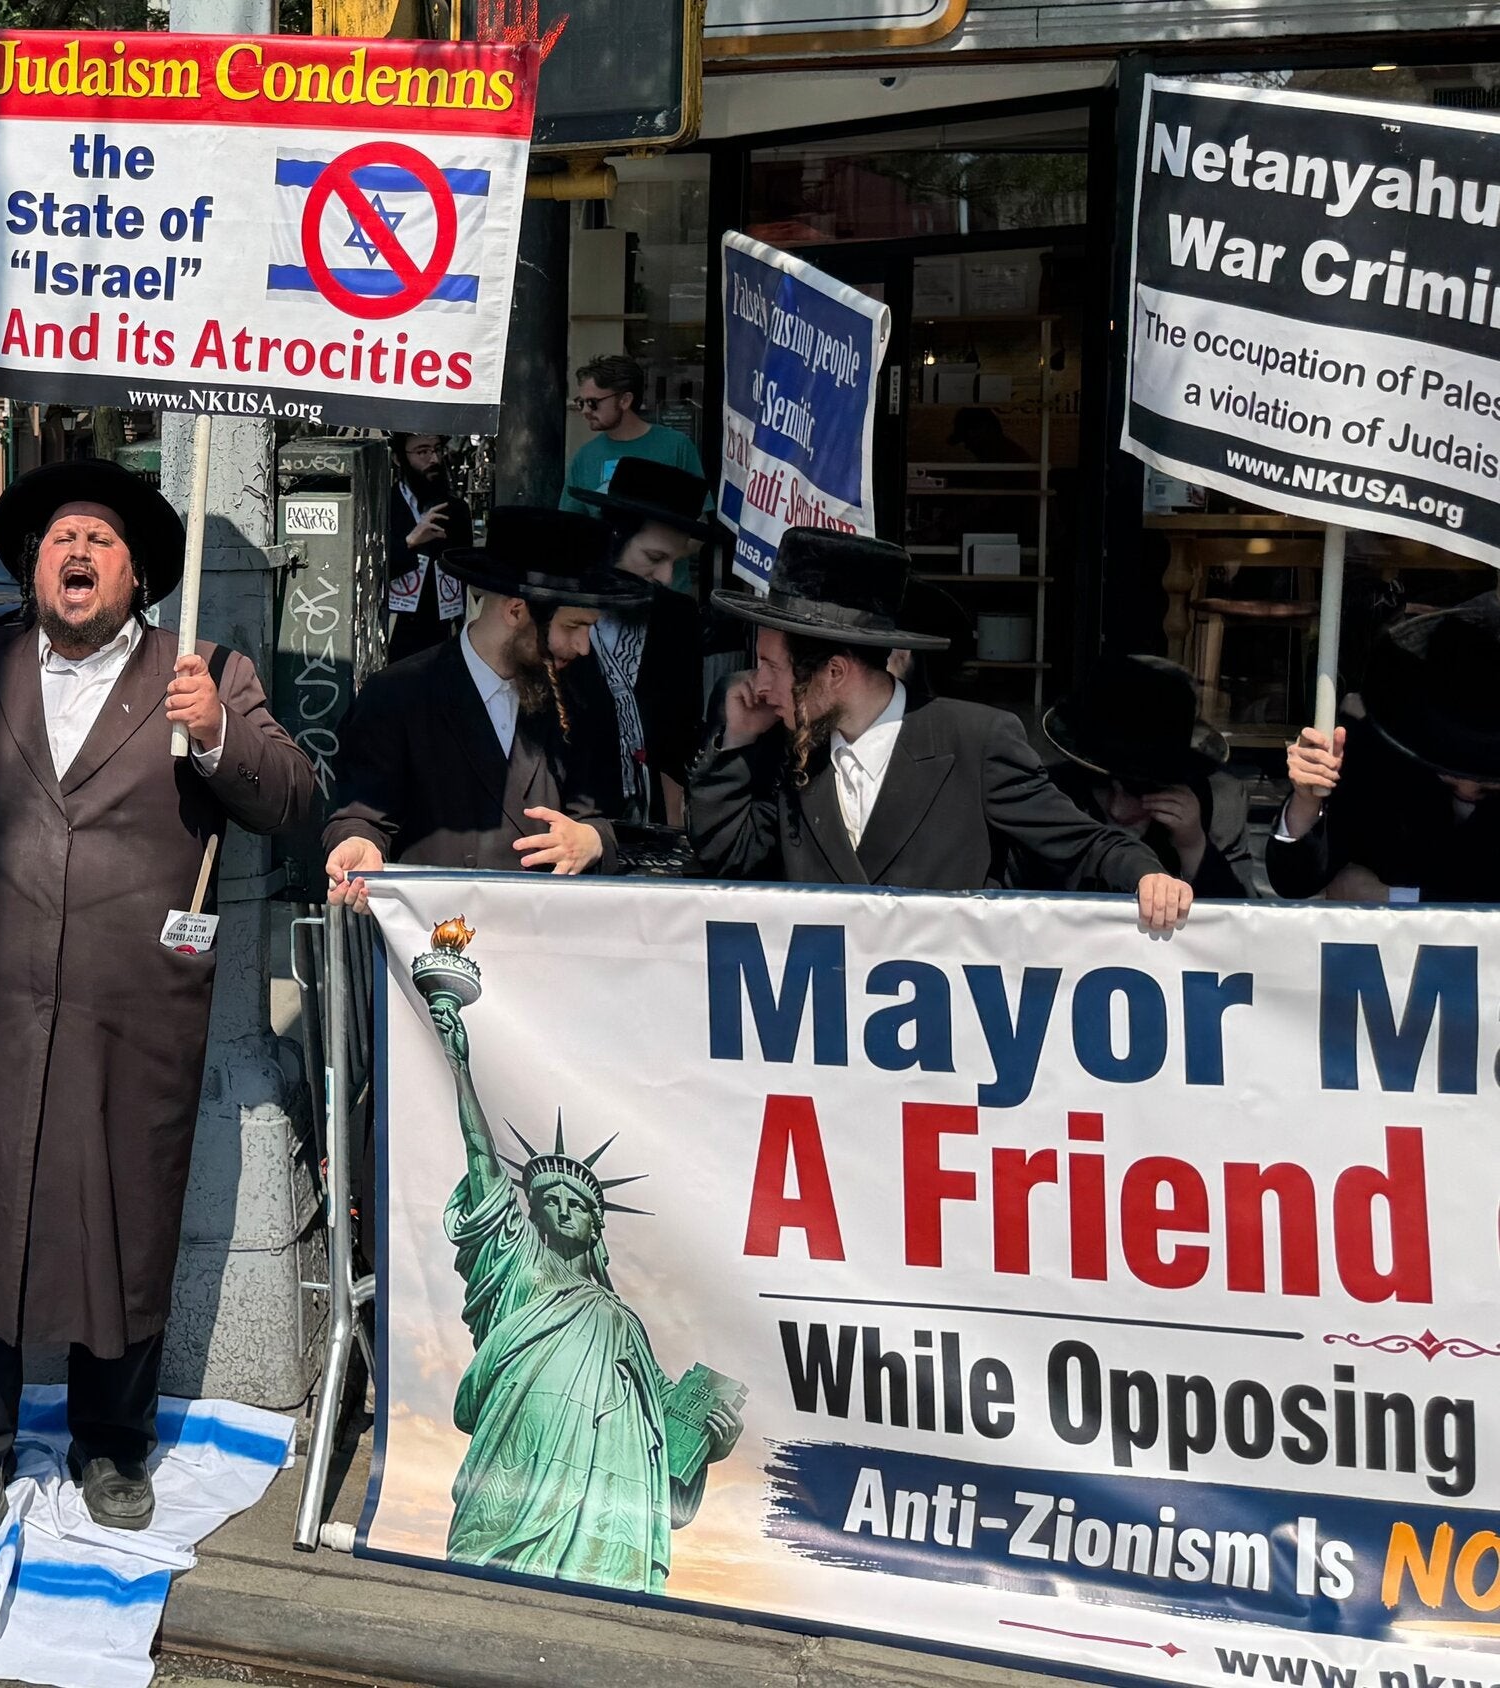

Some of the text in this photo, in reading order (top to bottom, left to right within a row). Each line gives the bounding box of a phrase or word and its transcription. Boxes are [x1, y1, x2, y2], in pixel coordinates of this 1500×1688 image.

[215, 43, 515, 112] Condemns
[69, 134, 155, 180] the
[1151, 122, 1500, 228] Netanyahu
[6, 190, 214, 243] State of
[1168, 213, 1500, 329] War Crimi
[1, 307, 473, 391] And its Atrocities
[813, 329, 860, 389] people
[1145, 309, 1187, 348] The
[1194, 329, 1365, 387] occupation
[1377, 365, 1416, 396] of
[127, 389, 324, 425] www.NKUSA.org
[1184, 382, 1500, 479] a violation of Judais
[1226, 448, 1464, 529] www.NKUSA.org
[706, 920, 1500, 1108] Mayor M
[743, 1094, 1434, 1305] A Friend
[778, 1320, 1476, 1499] While Opposing
[842, 1466, 1270, 1593] Anti-Zionism
[1297, 1515, 1355, 1601] Is
